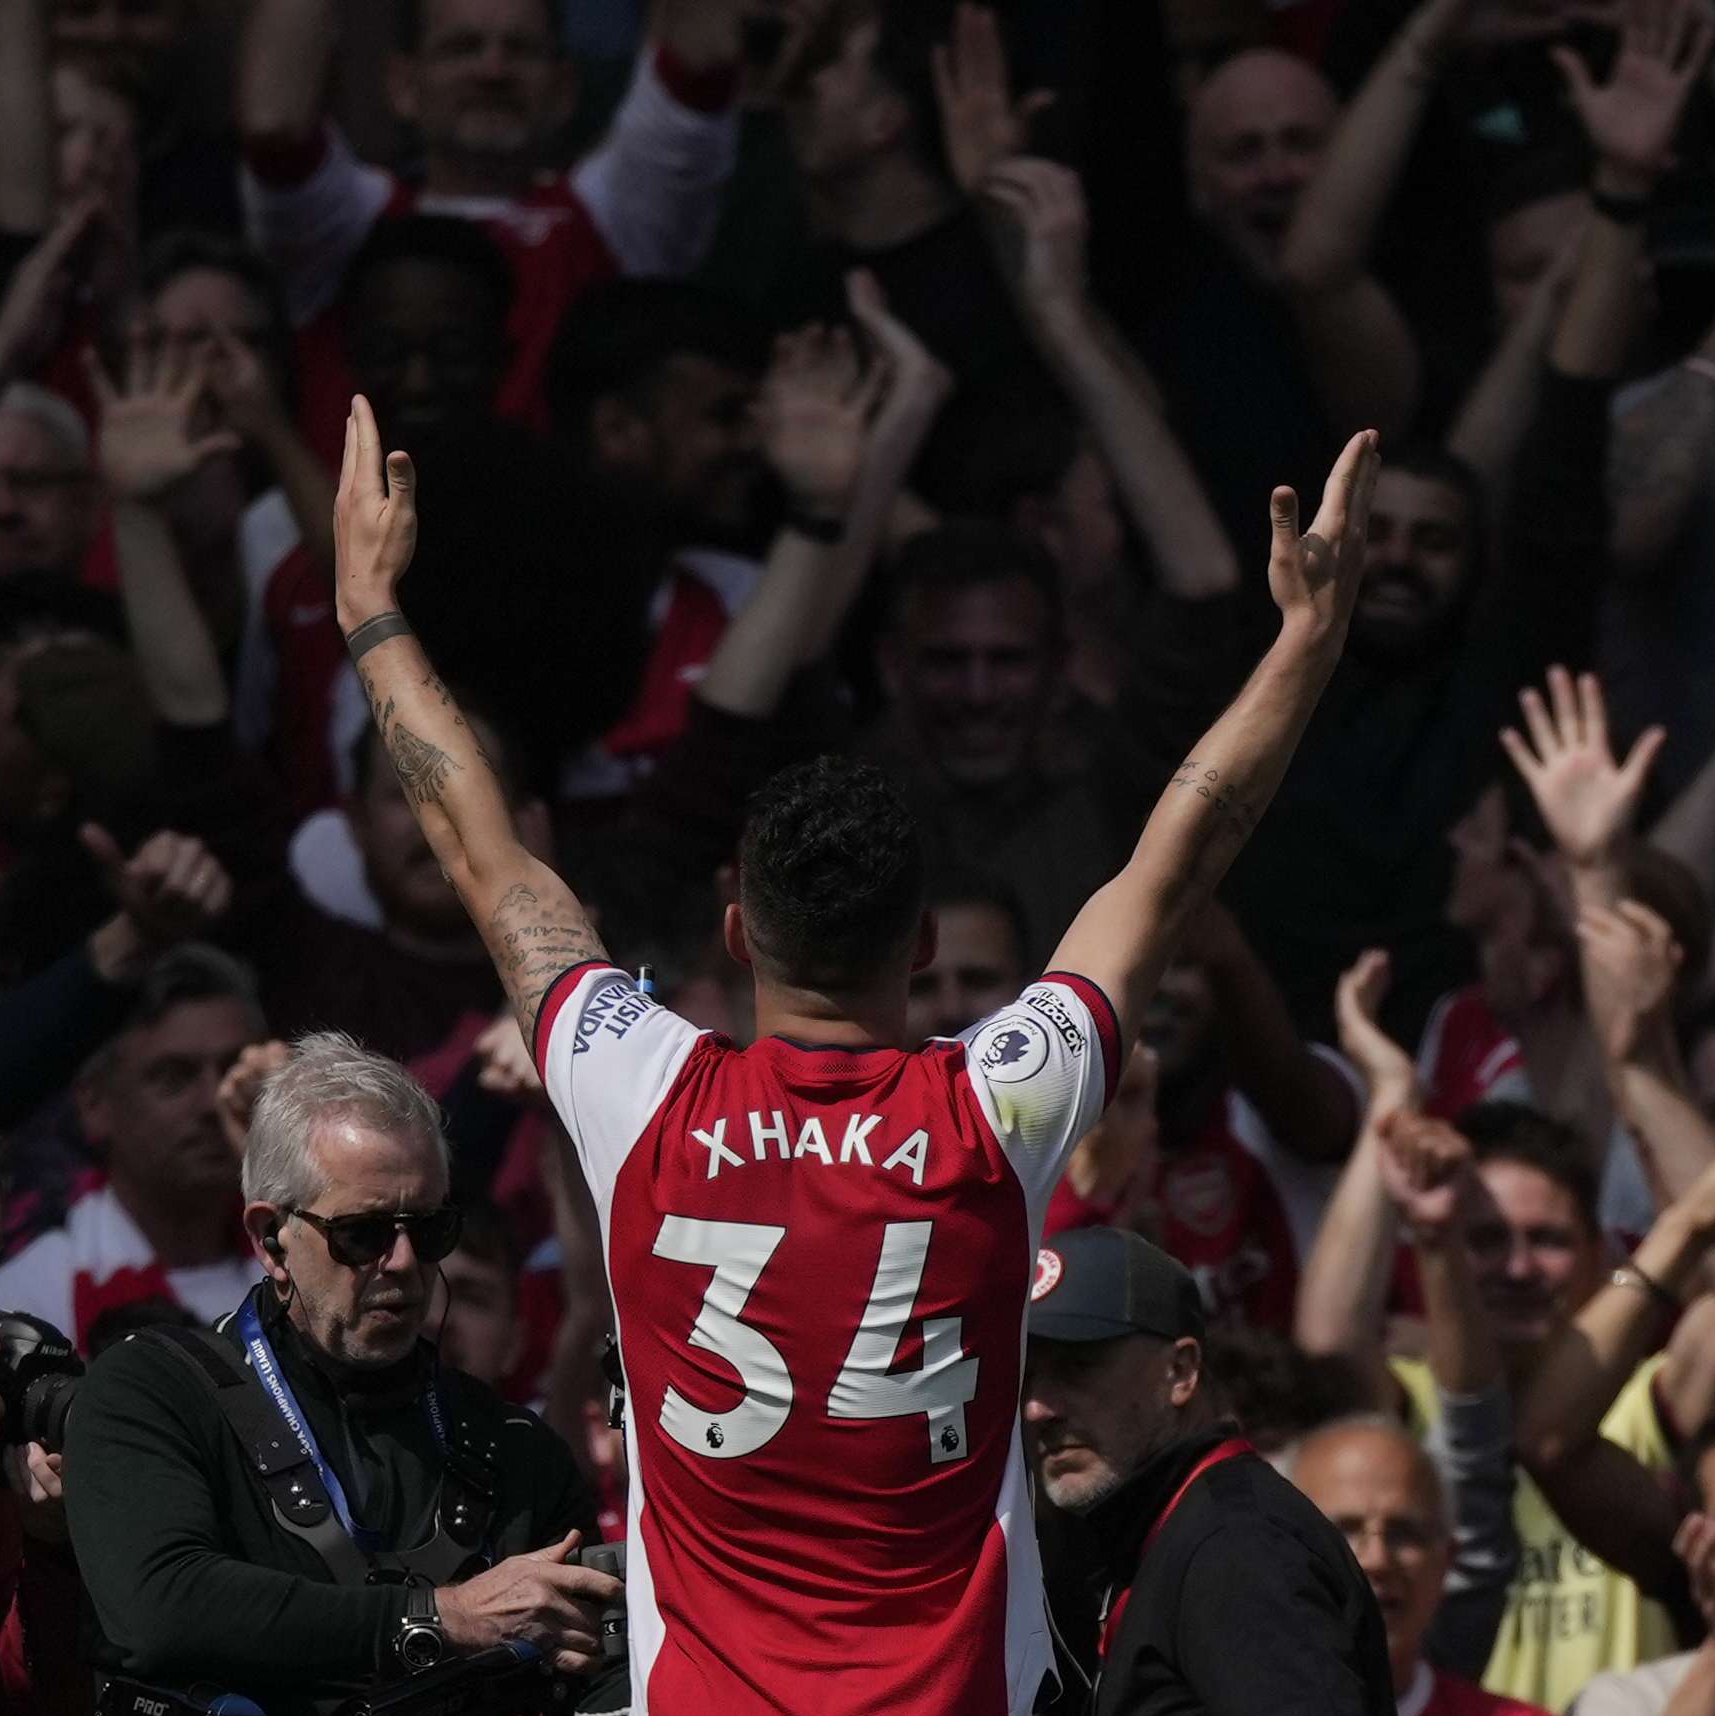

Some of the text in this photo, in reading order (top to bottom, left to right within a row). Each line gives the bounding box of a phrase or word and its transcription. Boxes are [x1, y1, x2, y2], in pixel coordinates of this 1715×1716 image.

[605, 996, 657, 1039] VISIT
[691, 1110, 930, 1186] XHAKA
[249, 1337, 274, 1375] LEAGUE
[651, 1213, 981, 1464] 34
[266, 1374, 300, 1433] CHAMPIONS
